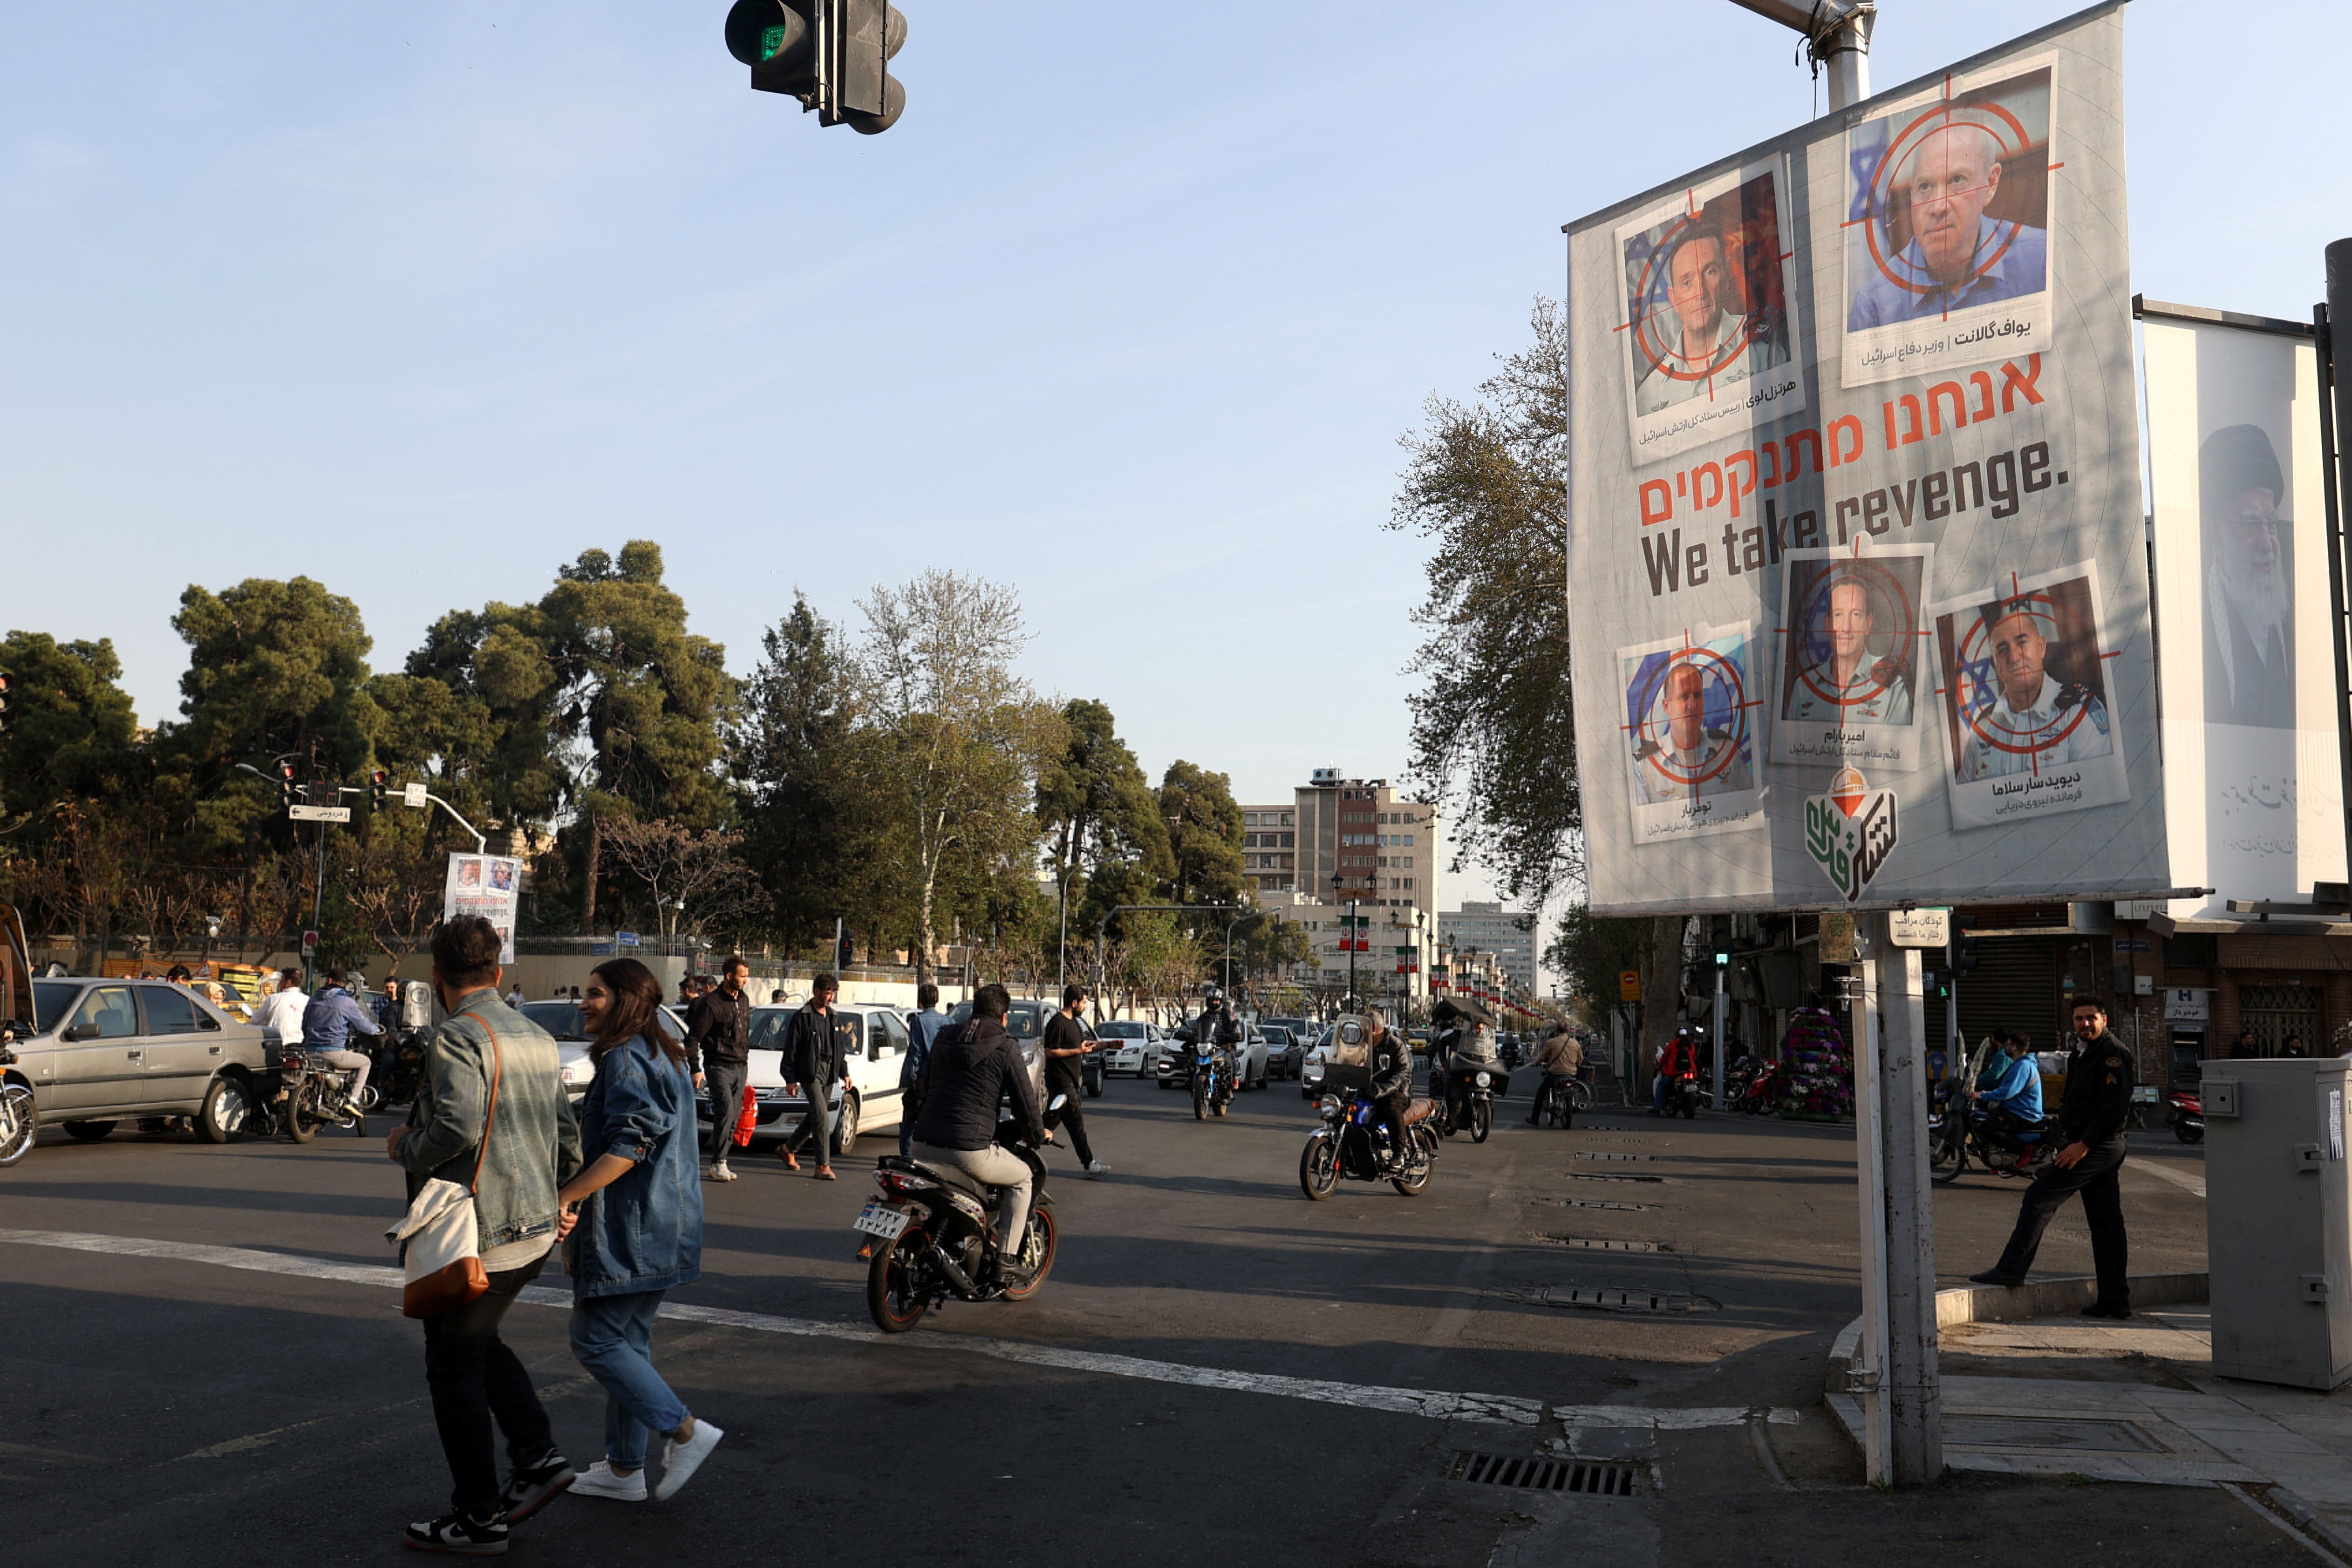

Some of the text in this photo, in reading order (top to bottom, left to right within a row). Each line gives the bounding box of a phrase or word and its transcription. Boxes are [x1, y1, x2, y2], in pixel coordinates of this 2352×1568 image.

[1861, 319, 2031, 366] یواف گالانت وزیر دفاع اسرائیل
[1746, 389, 1764, 408] لوی
[1765, 379, 1797, 402] هرتزل
[1687, 414, 1699, 430] کل
[1699, 411, 1718, 423] ستاد
[1639, 427, 1667, 445] اسرائیل
[1668, 418, 1687, 436] ارتش
[1638, 353, 2045, 527] אנחנו מתנקמים
[1641, 441, 2069, 597] We take revenge.
[1824, 728, 1865, 745] امیر بارام
[1992, 771, 2081, 795] دیوید سار سلاما
[2025, 794, 2049, 809] نیروی
[2049, 787, 2083, 803] فرمانده
[1681, 801, 1711, 818] تومر بار
